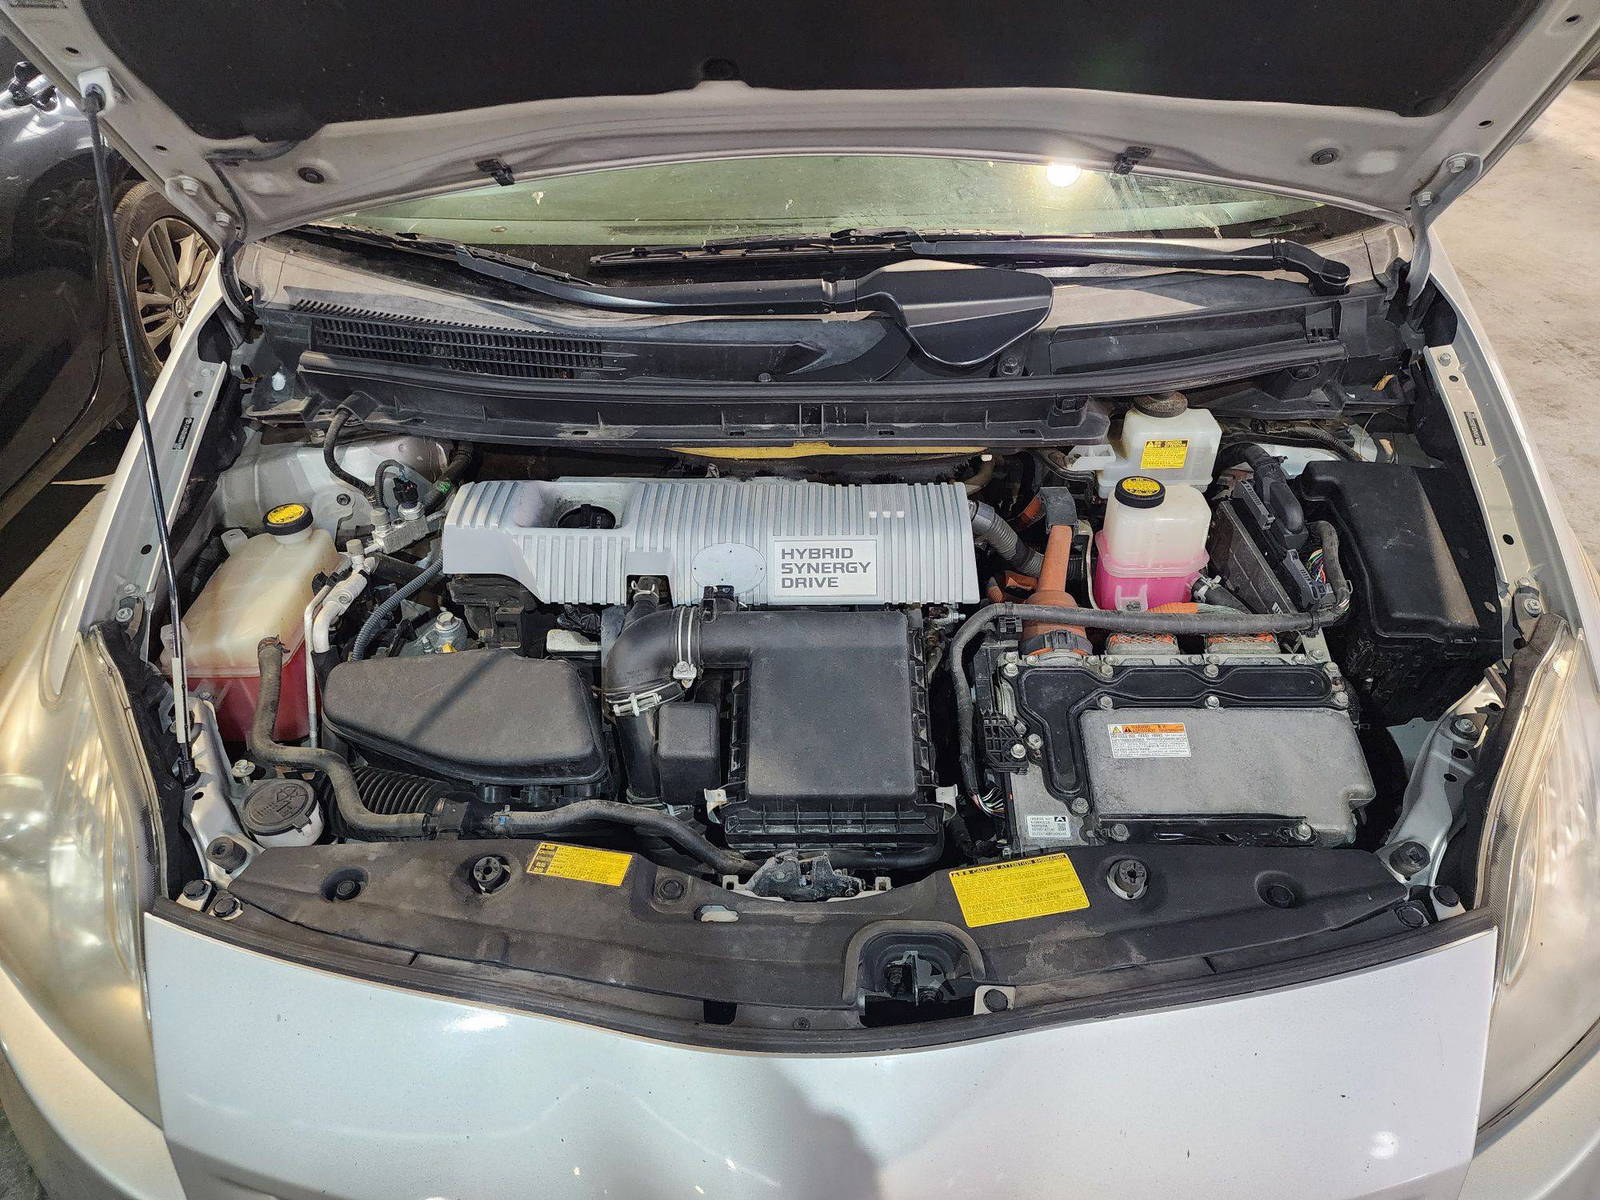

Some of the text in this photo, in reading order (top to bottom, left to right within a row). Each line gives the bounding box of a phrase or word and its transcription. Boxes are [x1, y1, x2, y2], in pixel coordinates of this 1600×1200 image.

[781, 547, 854, 560] HYBRID
[781, 561, 872, 574] SYNERGY
[781, 576, 839, 589] DRIVE
